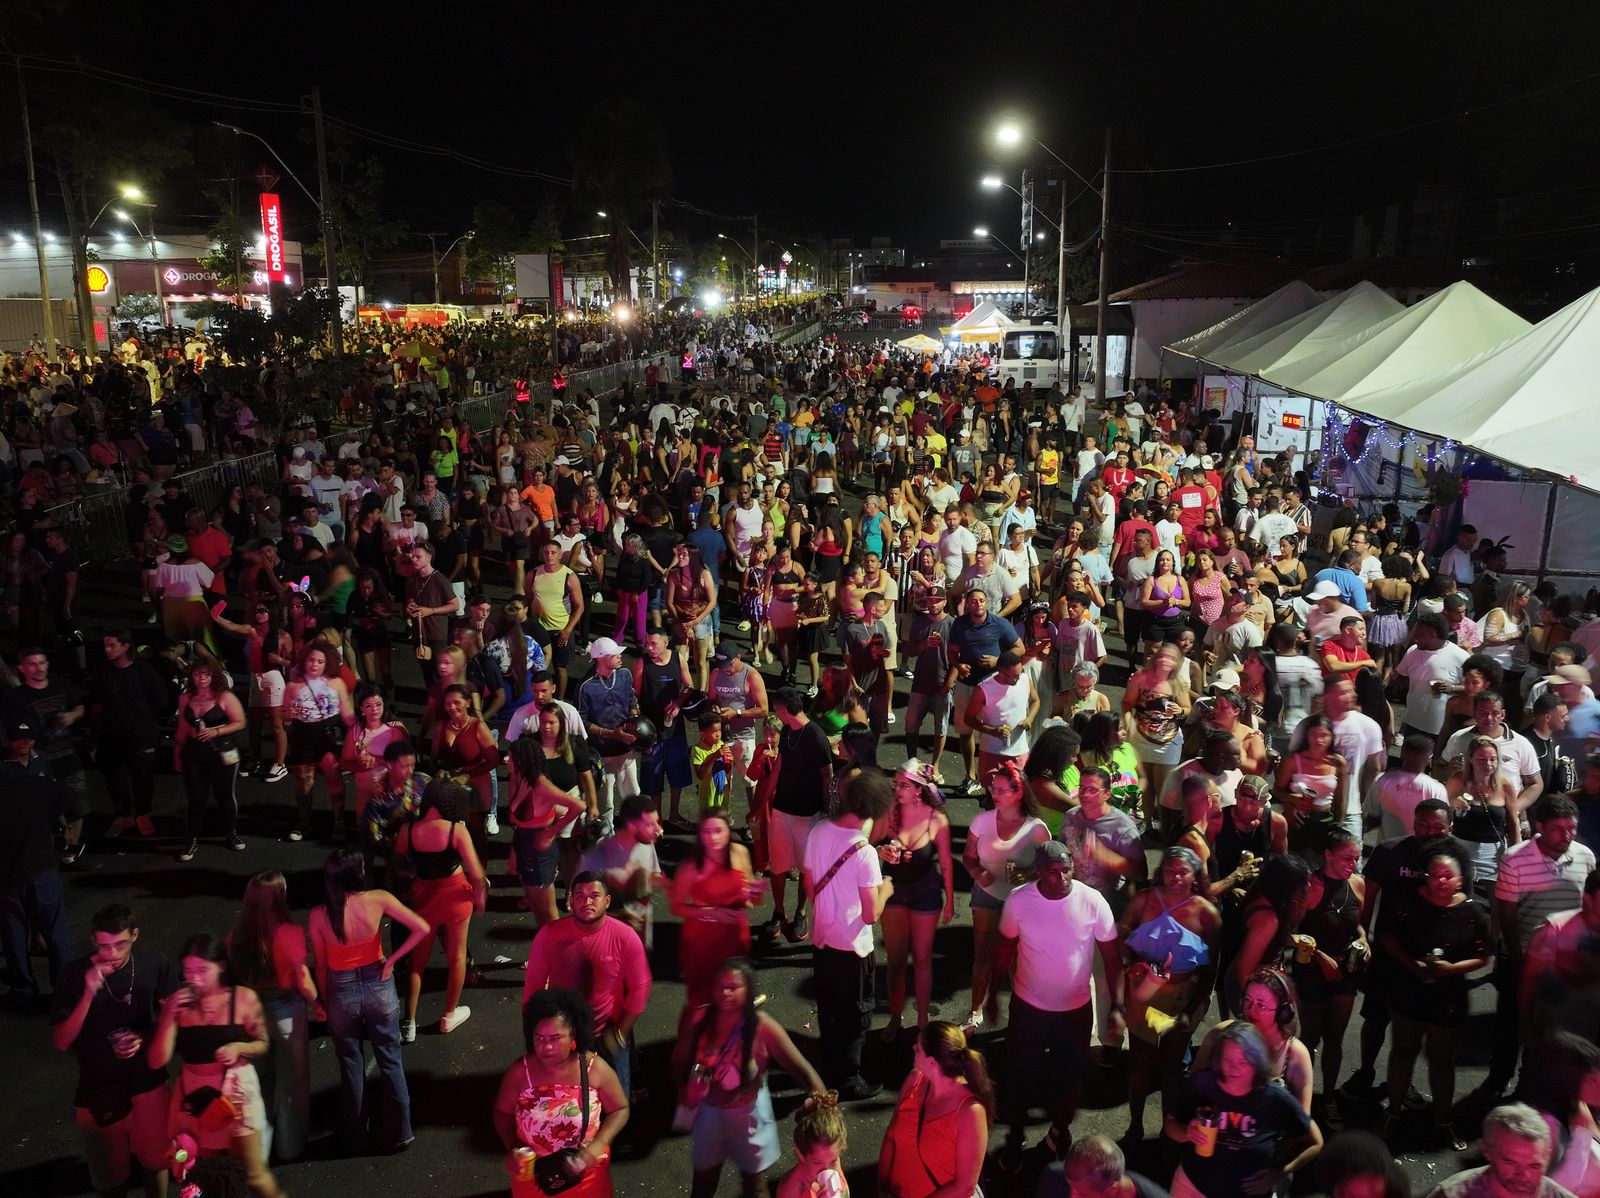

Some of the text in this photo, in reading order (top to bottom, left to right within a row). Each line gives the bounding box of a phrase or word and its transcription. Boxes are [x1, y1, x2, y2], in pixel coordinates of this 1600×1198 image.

[267, 205, 282, 271] DROGASIL
[182, 272, 223, 281] DROGAS
[956, 450, 970, 463] 75
